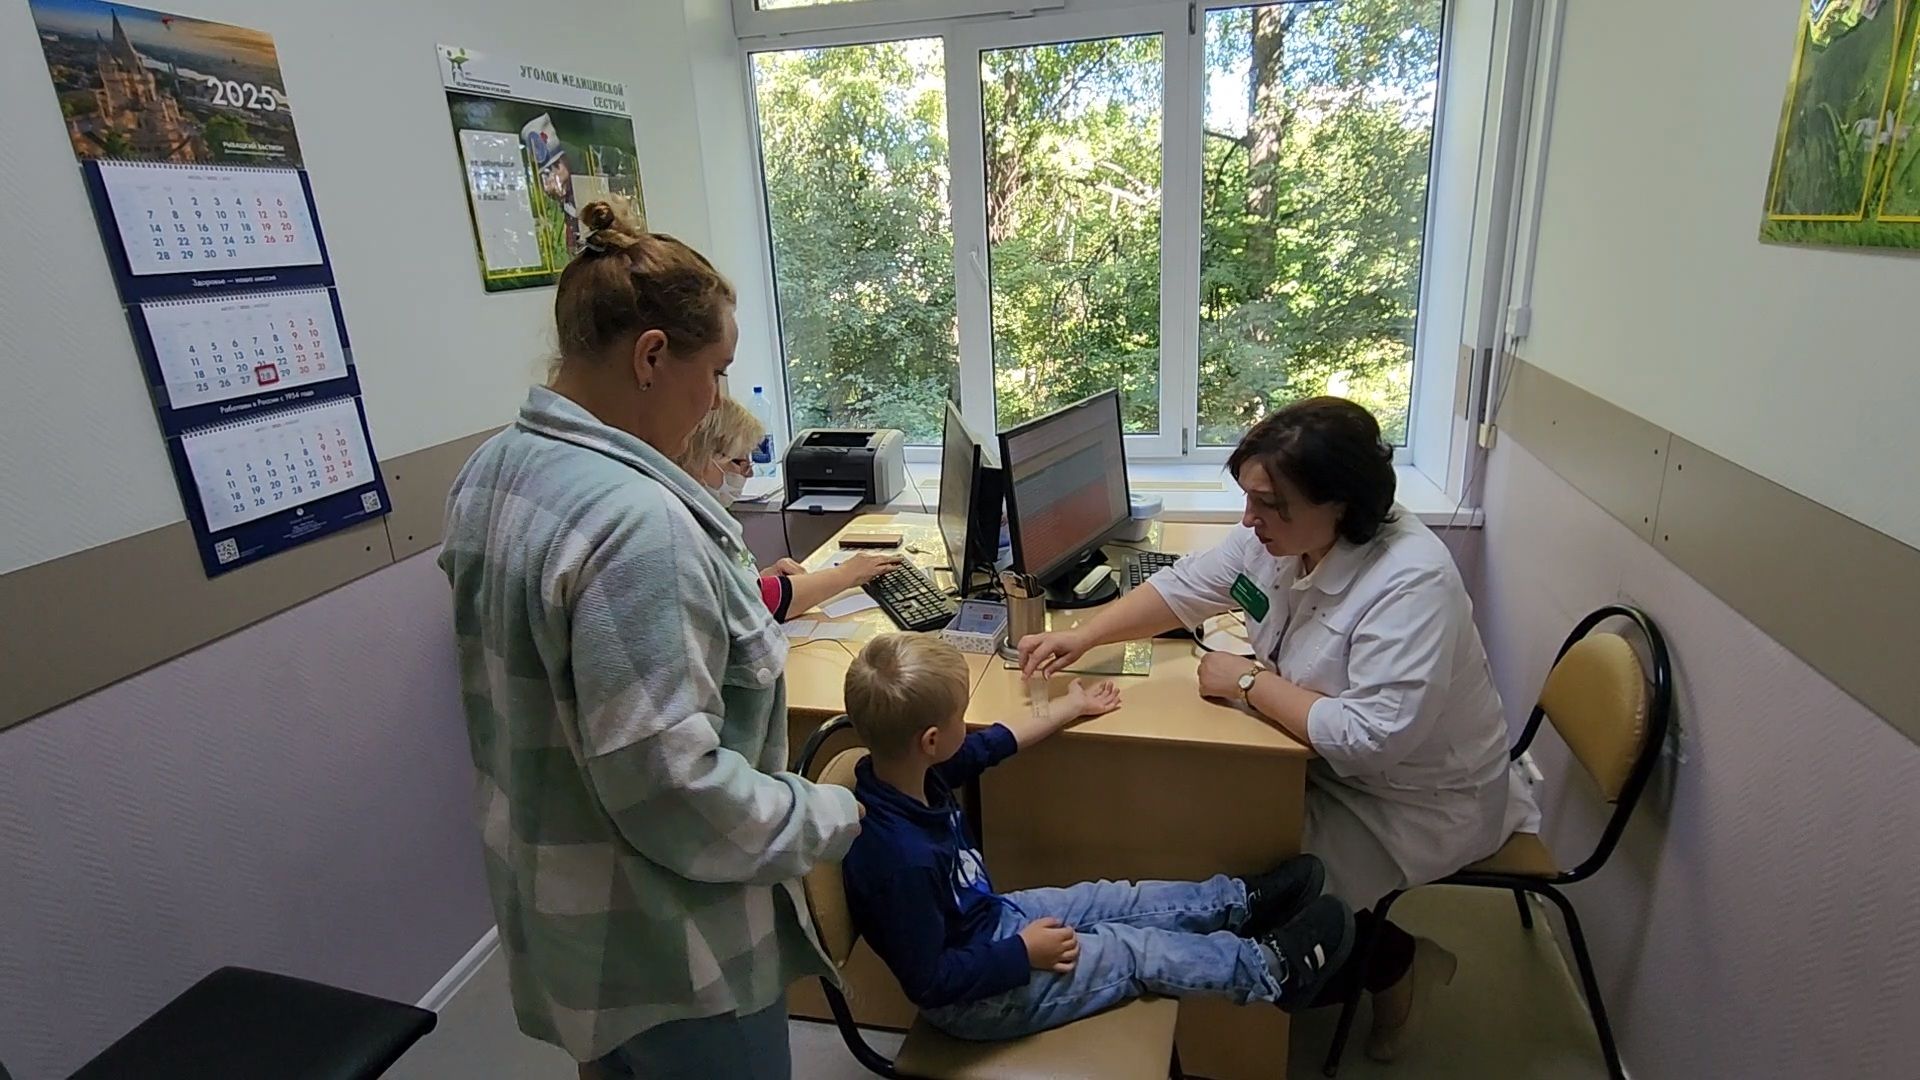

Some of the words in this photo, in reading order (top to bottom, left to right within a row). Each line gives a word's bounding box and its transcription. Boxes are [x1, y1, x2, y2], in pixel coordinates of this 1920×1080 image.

[520, 65, 559, 84] УГОЛОК
[561, 73, 624, 96] МЕДИЦИНСКОЙ
[207, 75, 276, 112] 2025
[593, 96, 626, 112] СЕСТРЫ
[147, 210, 153, 219] 7
[172, 210, 179, 219] 8
[195, 210, 202, 219] 9
[215, 210, 227, 219] 10
[237, 210, 246, 219] 11
[258, 210, 268, 219] 12
[278, 210, 288, 219] 13
[168, 197, 174, 205] 1
[191, 197, 198, 206] 2
[214, 197, 221, 206] 3
[236, 198, 242, 206] 4
[256, 198, 262, 206] 5
[276, 198, 283, 207] 6
[149, 224, 162, 233] 14
[174, 223, 186, 232] 15
[197, 223, 209, 232] 16
[220, 223, 229, 232] 17
[241, 223, 251, 231] 18
[261, 223, 271, 231] 19
[280, 222, 292, 231] 20
[153, 237, 164, 247] 21
[177, 237, 190, 246] 22
[200, 236, 213, 245] 23
[222, 236, 235, 245] 24
[243, 235, 255, 244] 25
[264, 235, 276, 243] 26
[284, 234, 294, 243] 27
[156, 251, 170, 260] 28
[181, 250, 193, 259] 29
[204, 249, 217, 258] 30
[226, 249, 237, 257] 31
[269, 322, 274, 330] 1
[289, 320, 295, 328] 2
[308, 318, 314, 326] 3
[189, 345, 195, 353] 4
[211, 342, 217, 351] 5
[232, 339, 239, 348] 6
[252, 336, 258, 345] 7
[273, 334, 279, 342] 8
[309, 329, 319, 337] 10
[190, 357, 200, 366] 11
[212, 354, 223, 363] 12
[233, 351, 244, 360] 13
[254, 348, 265, 357] 14
[274, 345, 284, 354] 15
[293, 343, 303, 351] 16
[312, 340, 320, 348] 17
[194, 370, 205, 379] 18
[216, 366, 226, 375] 19
[236, 363, 248, 372] 20
[277, 357, 287, 365] 22
[296, 354, 307, 363] 23
[314, 352, 325, 360] 24
[196, 382, 209, 392] 25
[218, 379, 231, 388] 26
[240, 375, 251, 384] 27
[280, 369, 290, 377] 29
[299, 365, 310, 374] 30
[317, 363, 326, 371] 31
[300, 437, 304, 445] 1
[317, 433, 323, 441] 2
[335, 428, 341, 436] 3
[246, 463, 252, 472] 5
[266, 458, 271, 466] 6
[284, 453, 289, 461] 7
[303, 448, 309, 456] 8
[320, 443, 326, 451] 9
[337, 438, 346, 447] 10
[227, 480, 236, 489] 11
[248, 474, 258, 483] 12
[267, 469, 277, 478] 13
[286, 464, 296, 472] 14
[304, 458, 314, 467] 15
[322, 454, 332, 462] 16
[340, 449, 348, 457] 17
[231, 492, 241, 501] 18
[251, 485, 261, 495] 19
[270, 480, 281, 490] 20
[289, 475, 298, 484] 21
[307, 469, 317, 478] 22
[325, 464, 335, 473] 23
[342, 459, 352, 468] 24
[233, 503, 245, 513] 25
[254, 497, 265, 507] 26
[273, 491, 283, 501] 27
[292, 486, 303, 495] 28
[310, 480, 320, 489] 29
[328, 475, 338, 484] 30
[345, 470, 354, 478] 31
